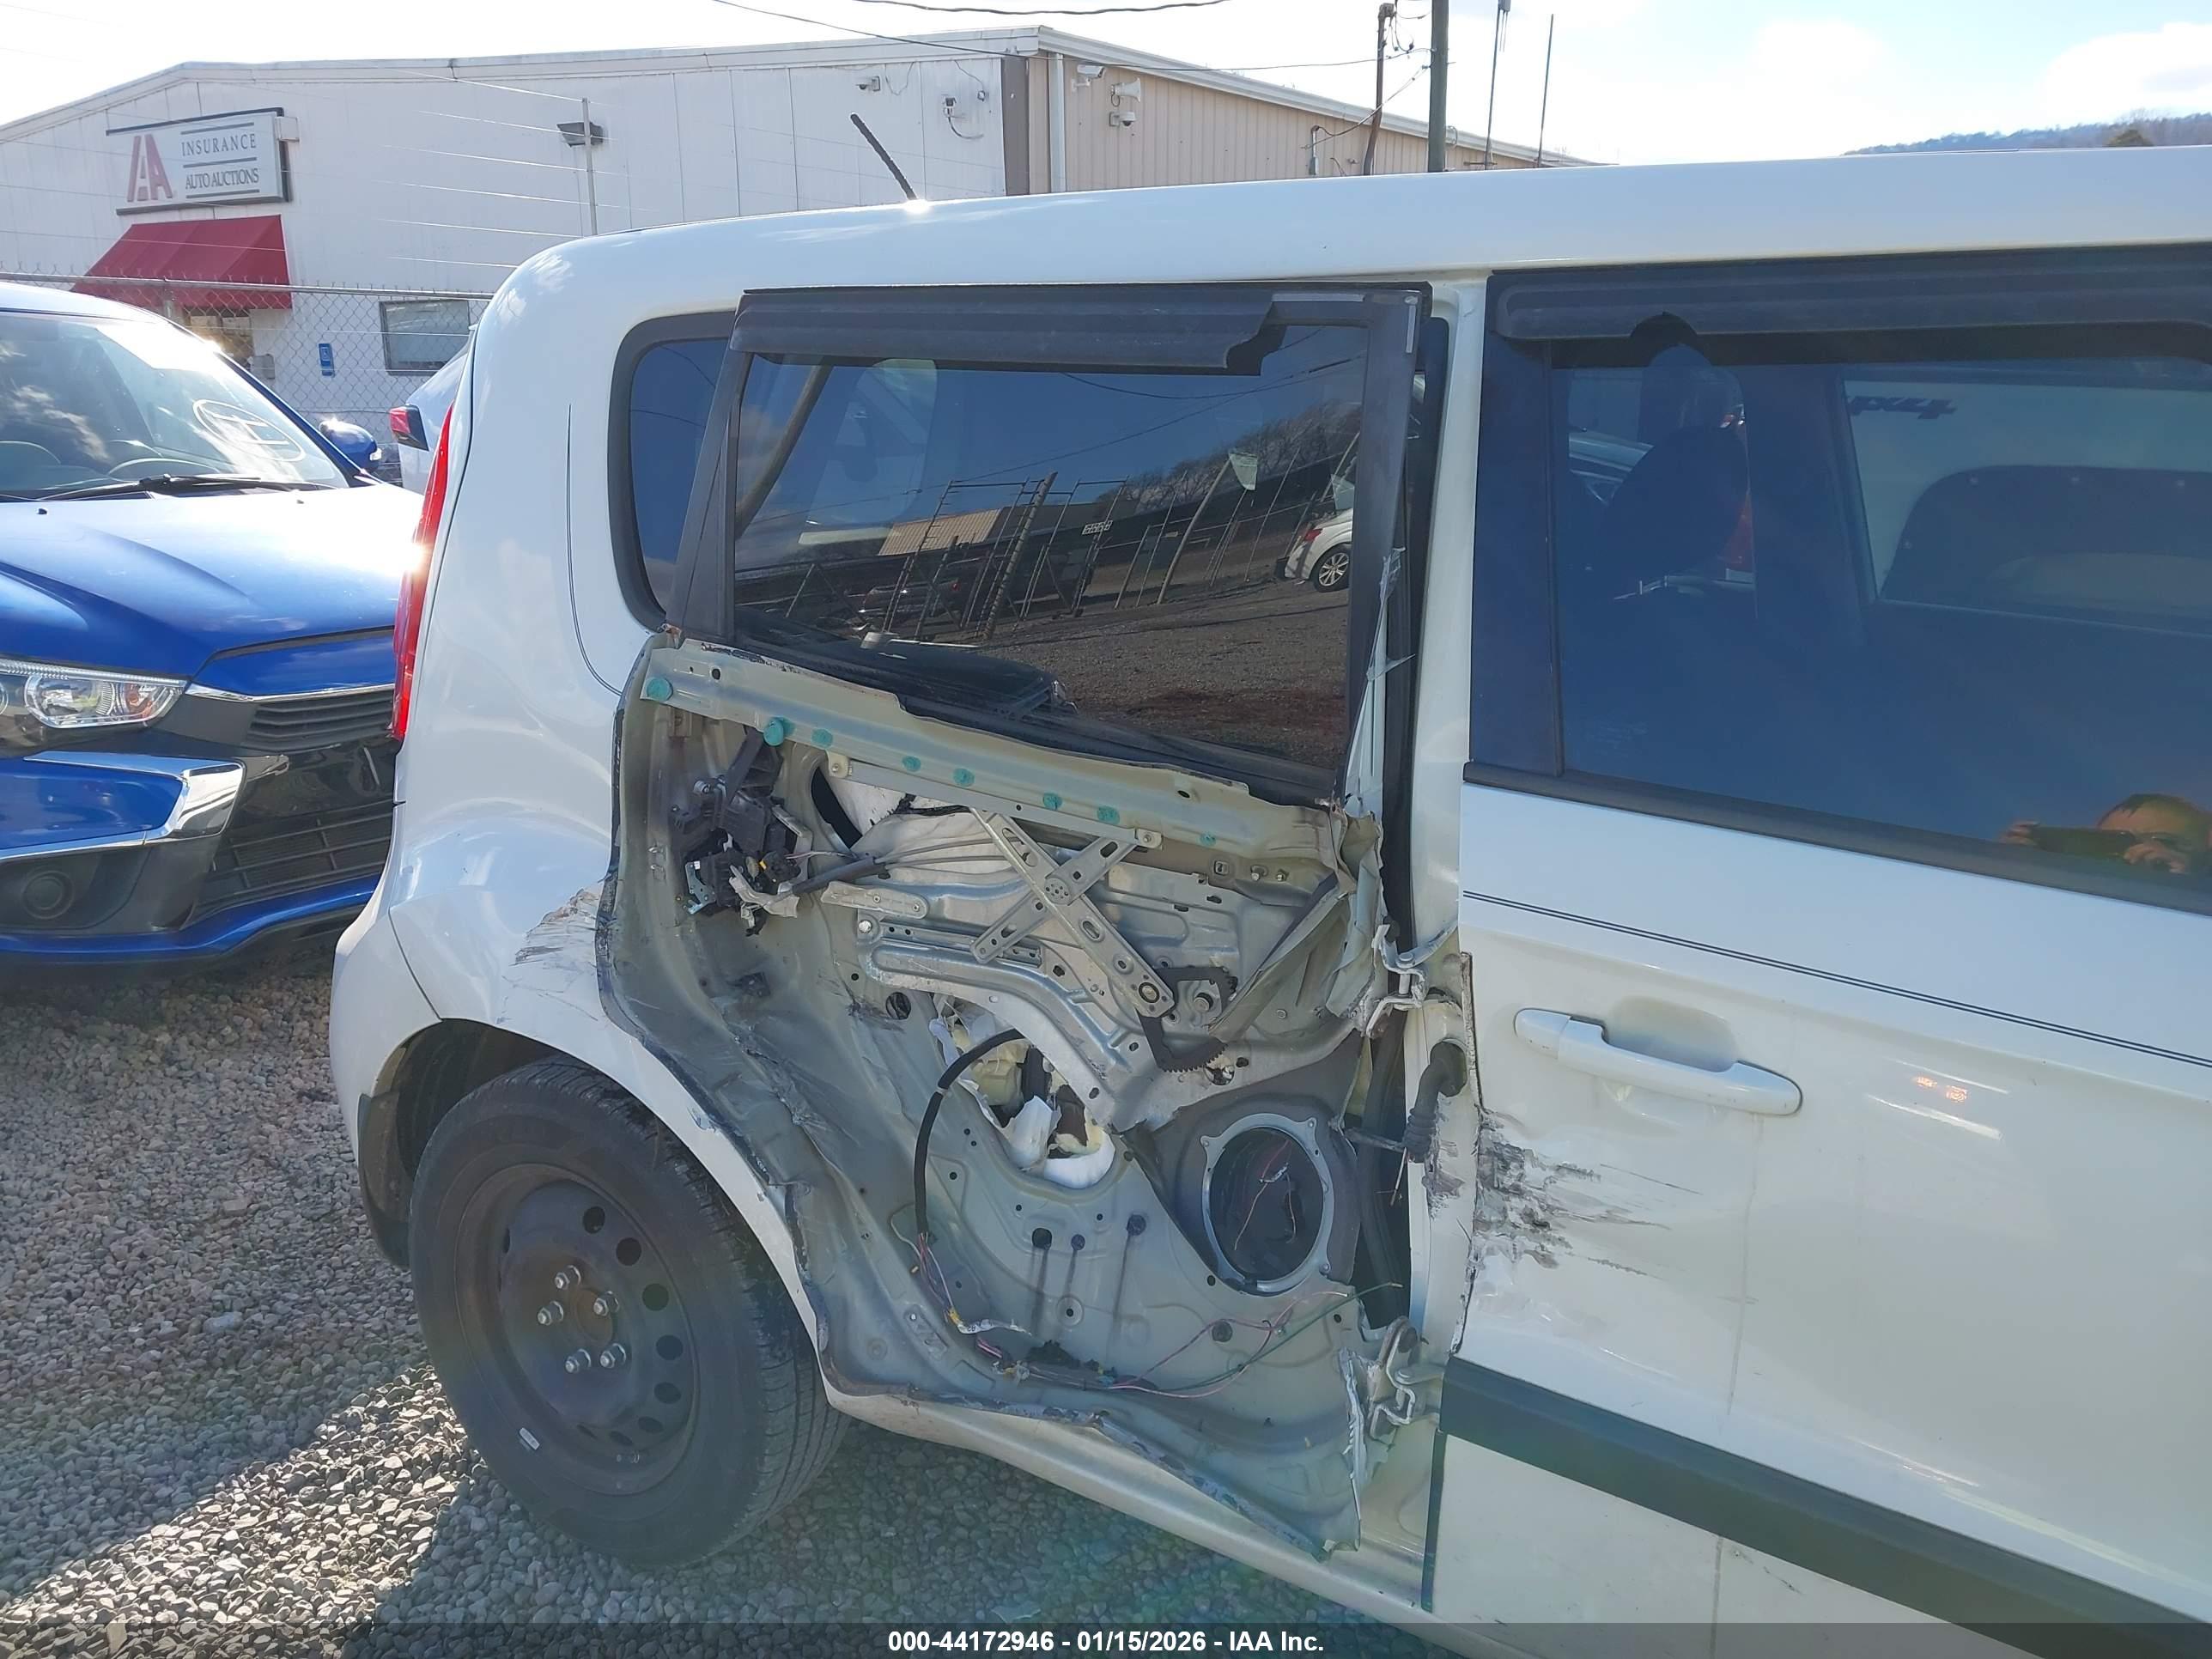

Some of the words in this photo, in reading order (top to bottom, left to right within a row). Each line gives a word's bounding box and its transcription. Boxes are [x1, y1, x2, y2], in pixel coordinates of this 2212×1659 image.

[181, 133, 256, 156] INSURANCE
[185, 173, 210, 190] AUTO
[211, 167, 259, 187] AUCTIONS
